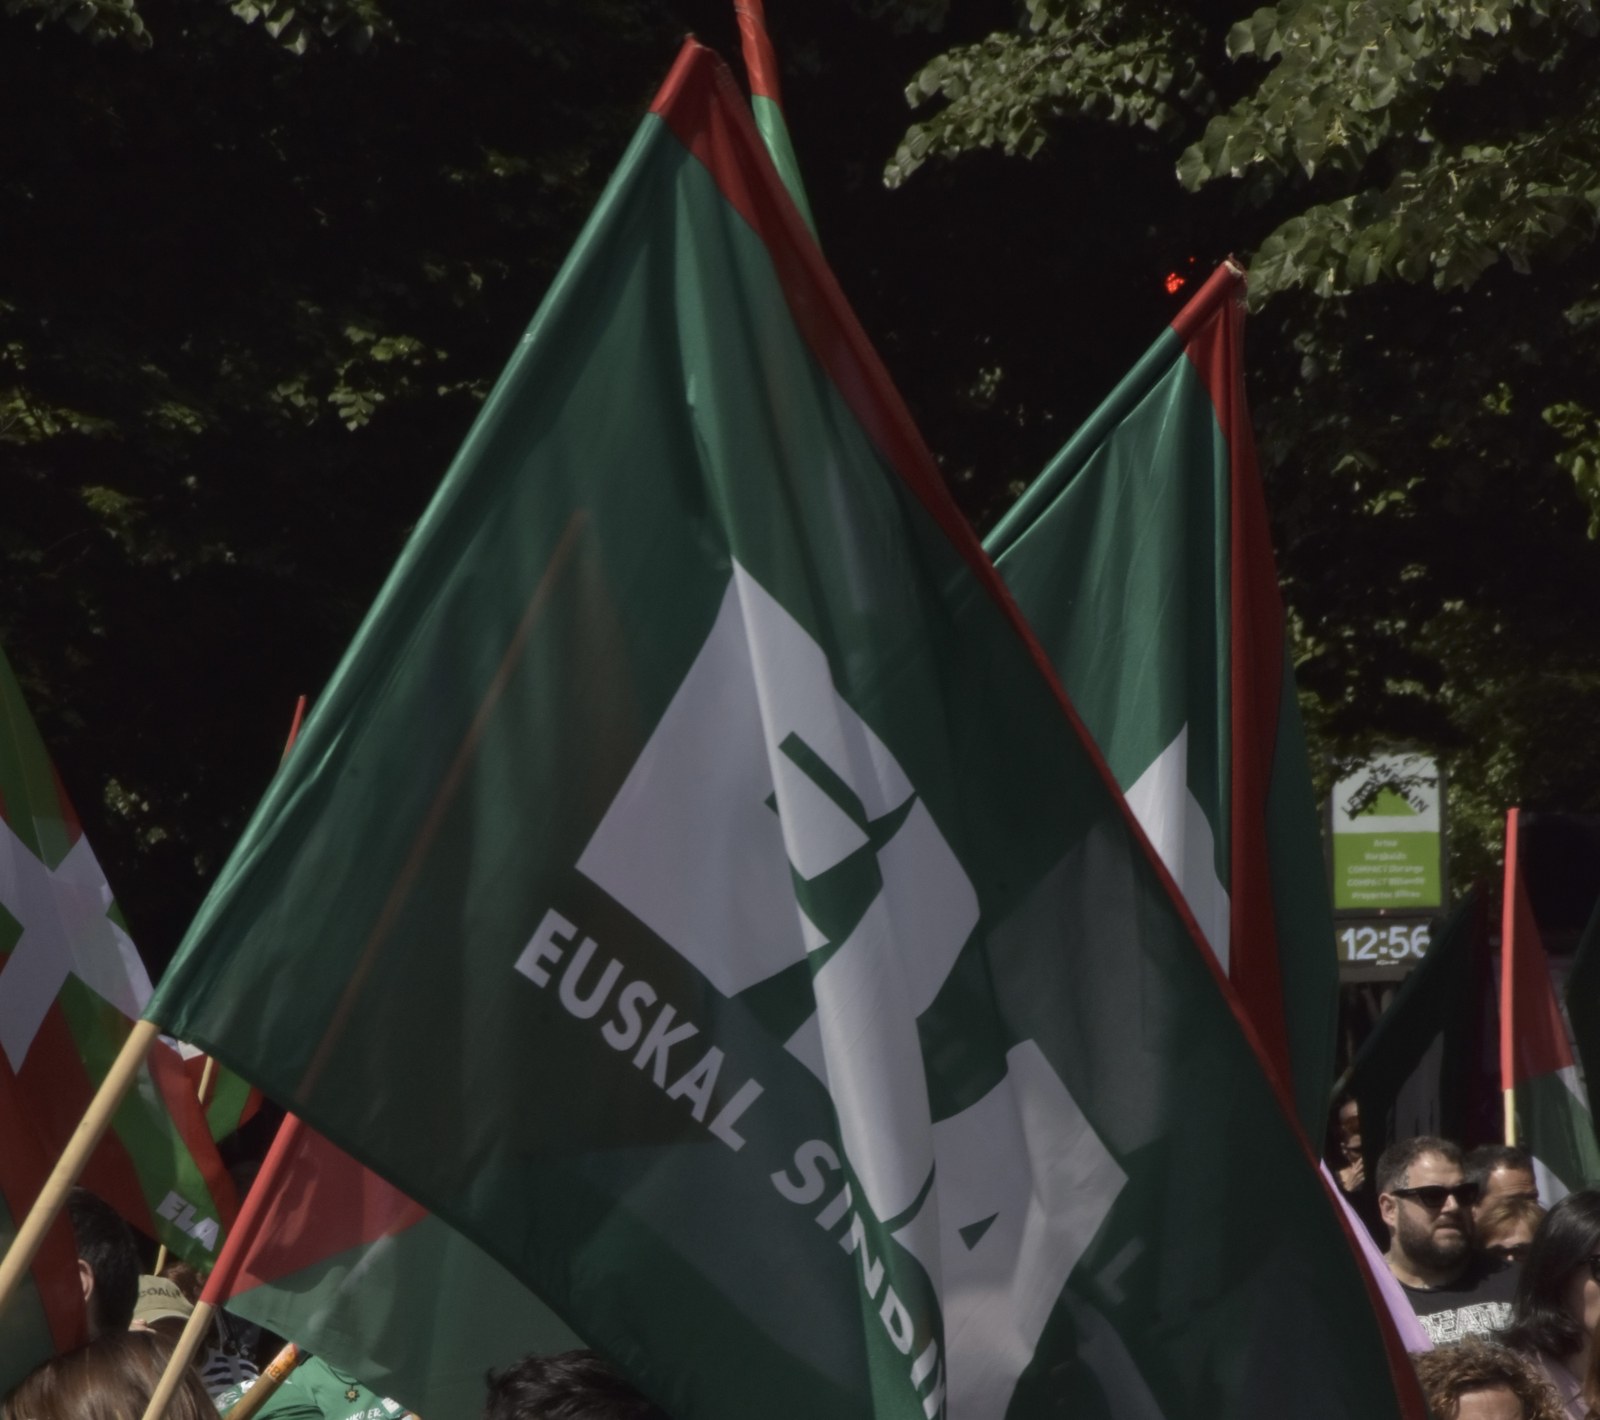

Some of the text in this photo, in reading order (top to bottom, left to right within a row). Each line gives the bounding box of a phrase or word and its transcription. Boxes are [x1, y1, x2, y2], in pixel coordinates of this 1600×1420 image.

[1340, 924, 1431, 961] 12:56
[513, 908, 765, 1152] EUSKAL
[155, 1189, 220, 1252] ELA
